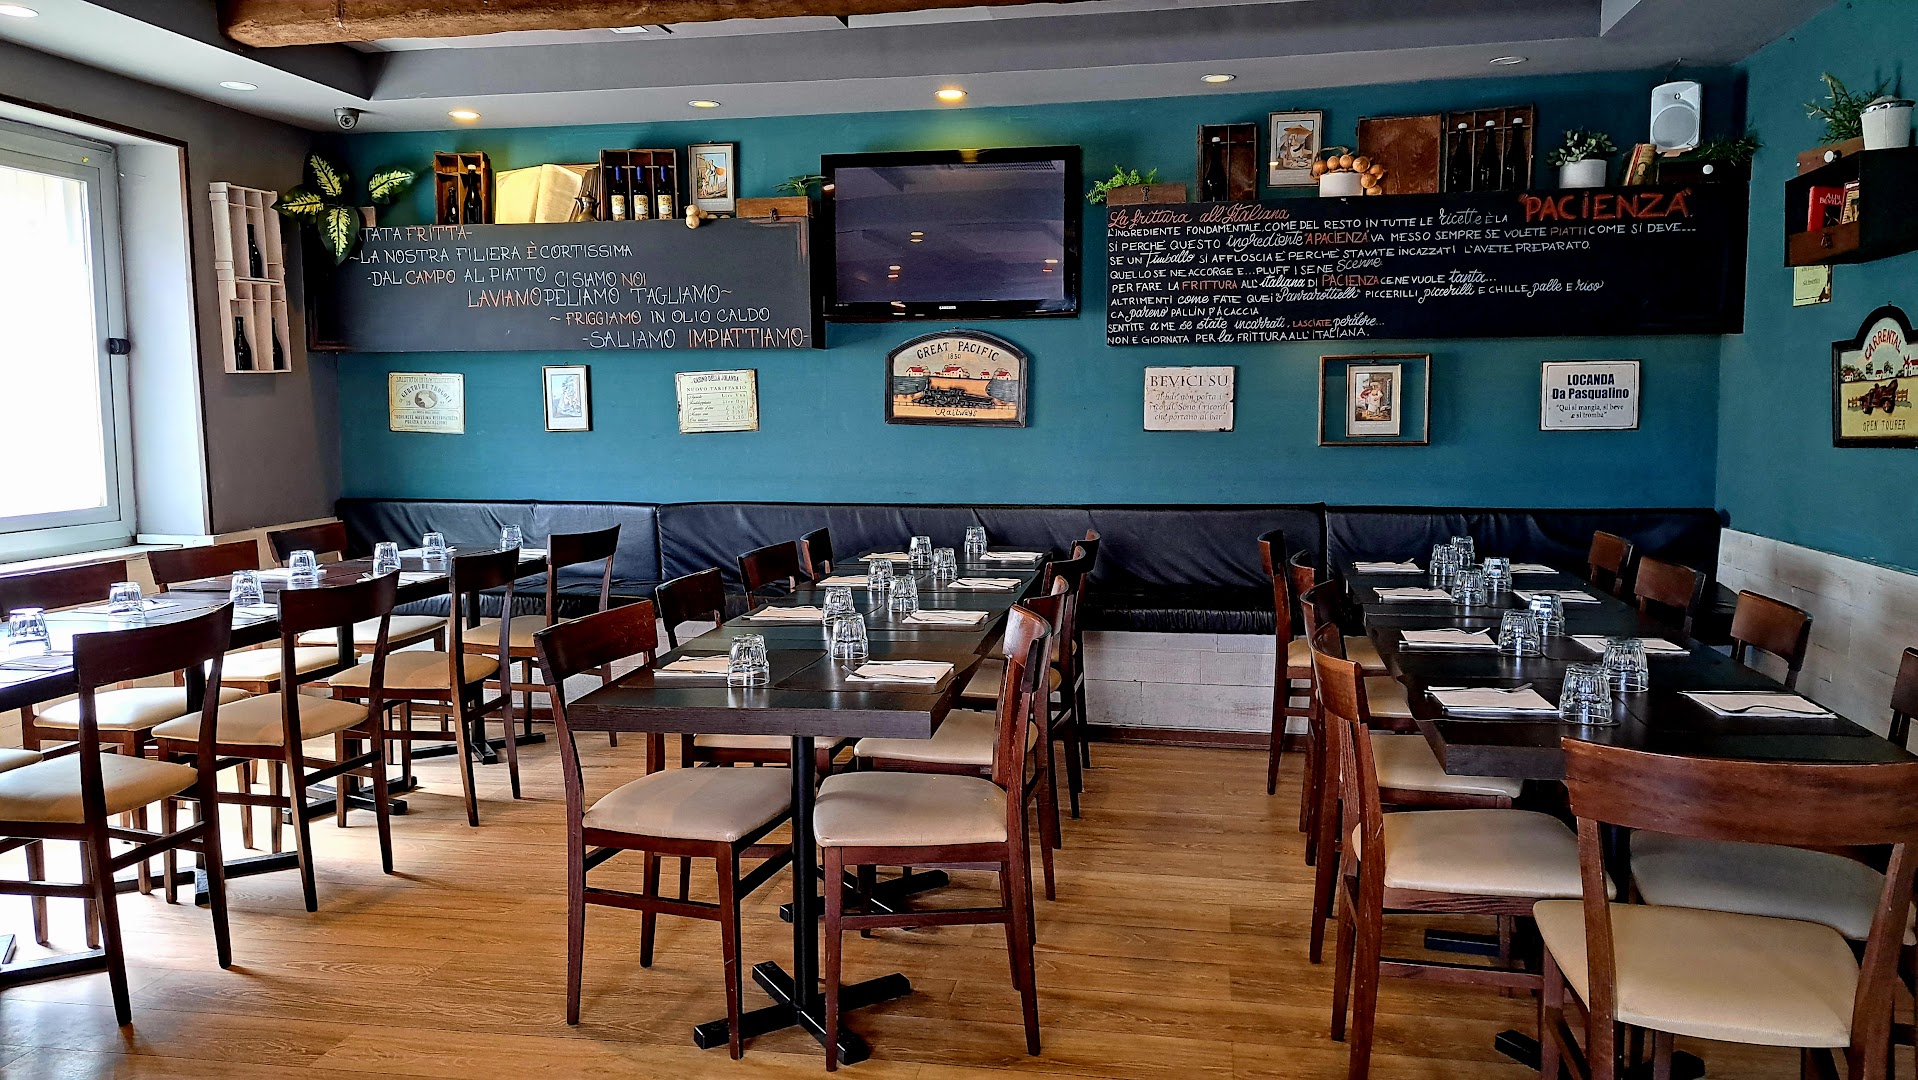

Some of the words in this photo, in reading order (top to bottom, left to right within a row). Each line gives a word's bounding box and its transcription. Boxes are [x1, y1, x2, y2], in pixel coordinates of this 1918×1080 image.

[1108, 209, 1129, 229] La
[1129, 209, 1193, 230] frittura
[1265, 221, 1298, 232] COME
[1300, 220, 1320, 230] DEL
[1324, 219, 1361, 230] RESTO
[1381, 218, 1417, 228] TUTTE
[1420, 217, 1434, 226] LE
[1439, 208, 1482, 225] ricette
[1496, 215, 1508, 223] LA
[359, 227, 402, 242] TATA
[1170, 239, 1221, 250] QUESTO
[1371, 234, 1385, 242] VA
[1391, 232, 1431, 242] MESSO
[1435, 230, 1482, 241] SEMPRE
[1485, 229, 1501, 239] SE
[1504, 227, 1547, 239] VOLETE
[1550, 227, 1587, 237] PIATTI
[1588, 224, 1626, 235] COME
[384, 248, 450, 264] NOSTRA
[456, 246, 521, 262] FILIERA
[540, 244, 633, 259] CORTISSIMA
[1110, 256, 1125, 266] SE
[1127, 257, 1143, 265] UN
[1212, 253, 1273, 263] AFFLOSCIA
[1343, 249, 1395, 259] STAVATE
[406, 270, 456, 285] CAMPO
[464, 268, 485, 283] AL
[489, 266, 547, 283] PIATTO
[572, 271, 617, 288] SIAMO
[621, 271, 647, 287] NOI
[1188, 267, 1234, 277] ACCORGE
[1112, 283, 1134, 294] PER
[1136, 282, 1163, 292] FARE
[1168, 282, 1180, 291] LA
[1182, 280, 1238, 291] FRITTURA
[1308, 278, 1318, 288] DI
[1322, 274, 1379, 287] PACIENZA
[1411, 275, 1446, 284] VUOLE
[468, 287, 542, 308] LAVIAMO
[544, 287, 620, 307] PELIAMO
[1178, 295, 1210, 305] come
[1213, 295, 1242, 304] FATE
[1365, 290, 1418, 299] PICCERILLI
[1479, 286, 1486, 295] E
[1567, 283, 1573, 292] E
[566, 310, 642, 326] FRIGGIAMO
[651, 311, 666, 324] IN
[672, 310, 711, 323] OLIO
[717, 307, 770, 323] CALDO
[1111, 311, 1125, 319] CA
[1108, 323, 1145, 334] SENTITE
[1161, 322, 1176, 331] ME
[1196, 317, 1228, 330] state
[1107, 336, 1129, 345] NON
[1142, 335, 1190, 345] GIORNATA
[1196, 334, 1217, 343] PER
[1218, 329, 1235, 343] la
[917, 342, 950, 360] GREAT
[958, 341, 1000, 362] PACIFIC
[1150, 376, 1203, 387] BEVICI
[1209, 375, 1229, 387] SU
[1568, 374, 1615, 386] LOCANDA
[1553, 389, 1566, 399] Da
[1569, 388, 1630, 400] Pasqualino
[1863, 420, 1878, 432] OPEN
[1882, 419, 1907, 431] TOURER
